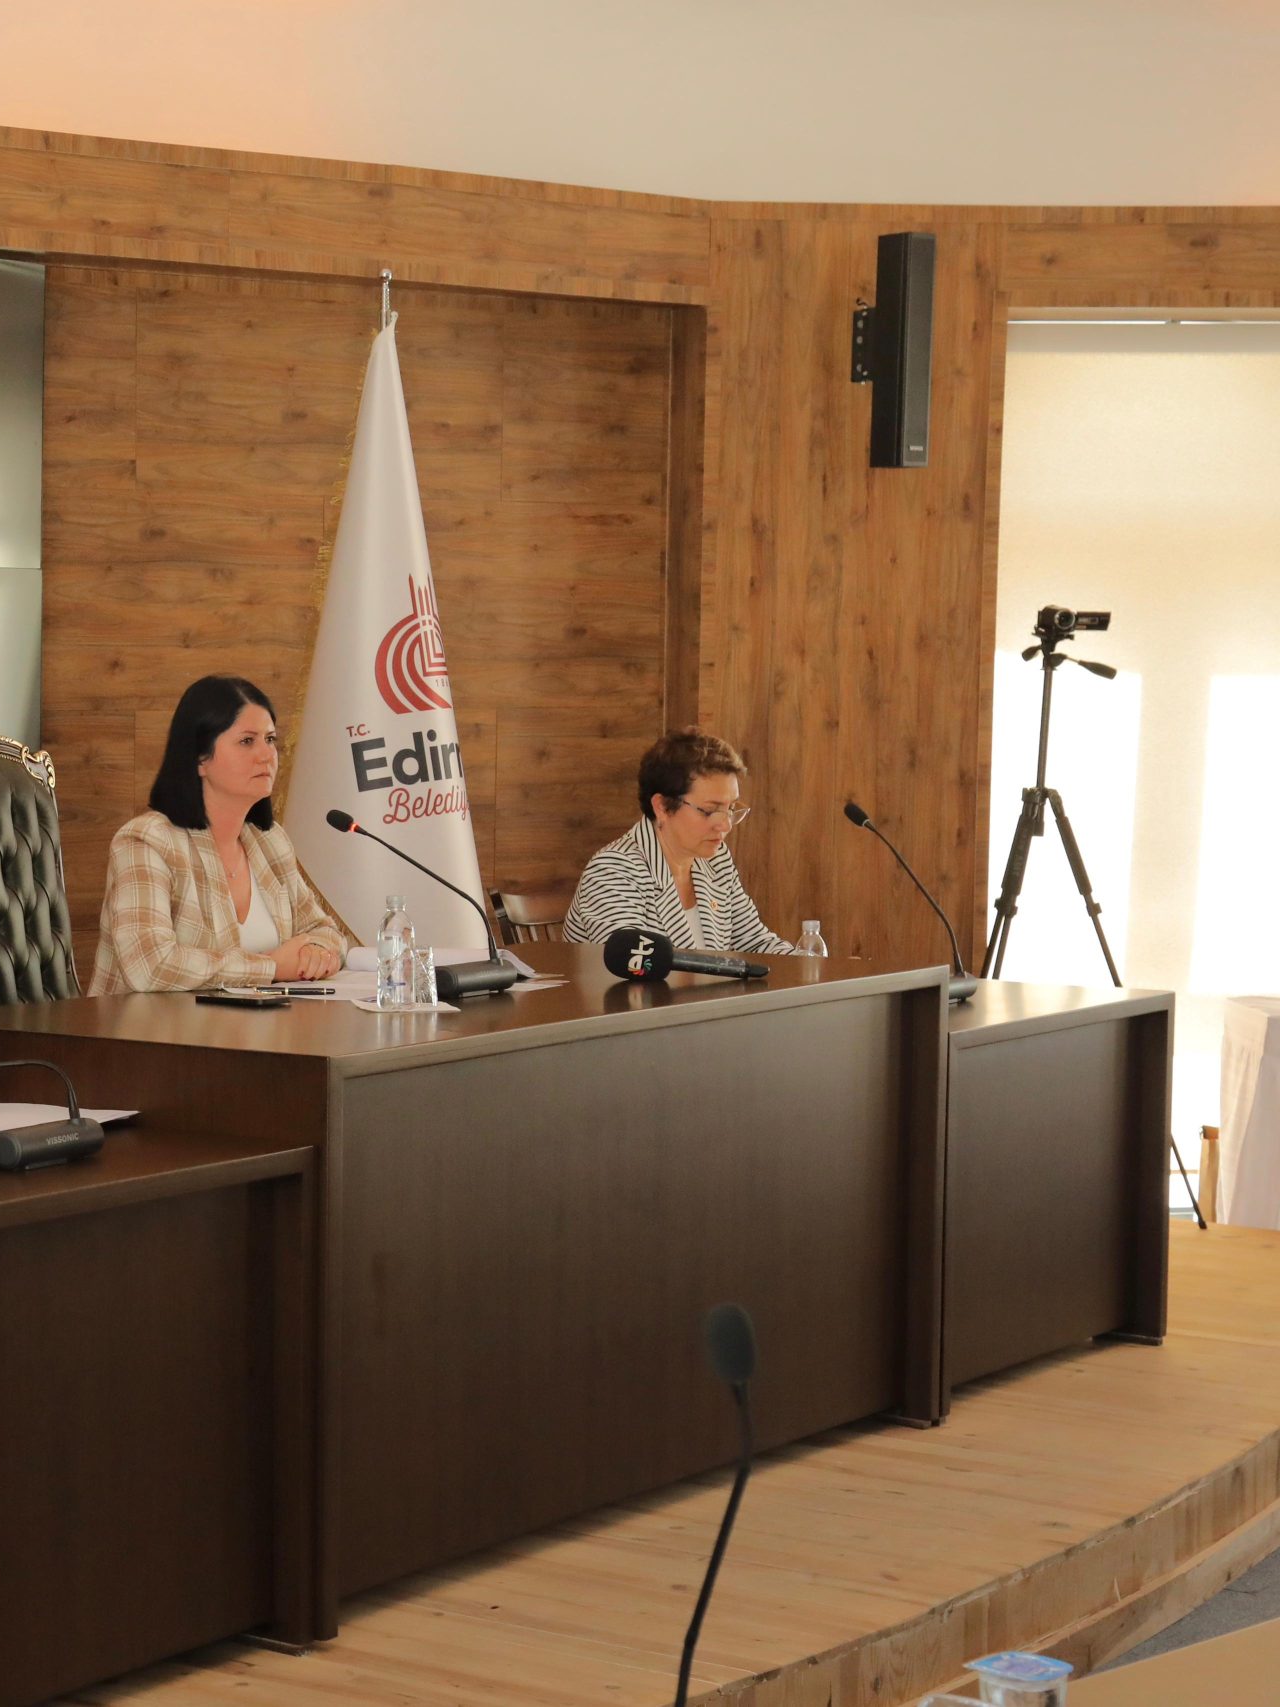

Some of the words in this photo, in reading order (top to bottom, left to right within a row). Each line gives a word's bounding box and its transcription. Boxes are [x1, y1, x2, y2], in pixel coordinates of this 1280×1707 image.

[346, 723, 371, 738] T.C.
[382, 785, 469, 825] Belediy
[45, 1132, 80, 1146] VISSONIC
